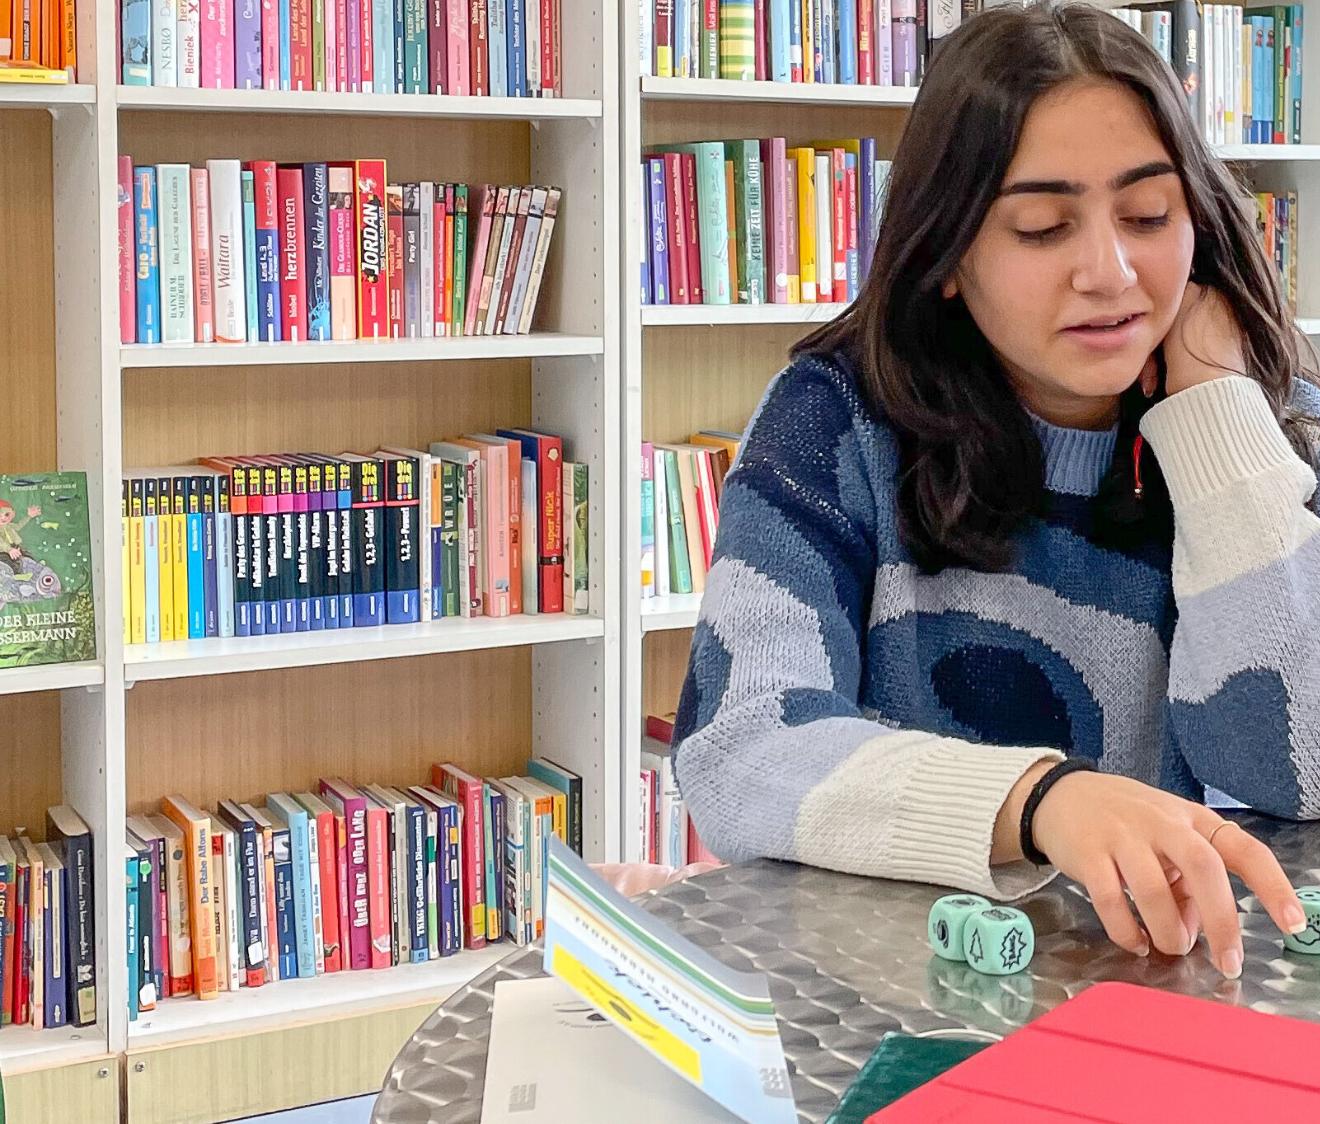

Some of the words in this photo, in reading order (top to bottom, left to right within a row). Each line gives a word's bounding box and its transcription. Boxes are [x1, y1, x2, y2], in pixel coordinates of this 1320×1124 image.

[161, 26, 172, 68] NESBØ
[184, 34, 195, 73] Bieniek
[747, 157, 759, 184] KÜHE
[310, 167, 325, 205] Gezeiten
[748, 186, 759, 206] FÜR
[750, 208, 760, 230] ZEIT
[284, 198, 298, 281] herzbrennen
[311, 219, 325, 250] Kinder
[361, 203, 379, 275] JORDAN
[750, 231, 761, 261] KEINE
[216, 234, 231, 289] Waitara
[408, 245, 416, 263] Party
[287, 294, 298, 318] blobel
[311, 512, 321, 549] VIP-Alarm
[545, 519, 557, 551] Super
[236, 545, 246, 558] des
[236, 559, 247, 579] Party
[26, 610, 76, 627] KLEINE
[350, 810, 366, 839] LANG
[198, 828, 208, 859] Alfons
[353, 839, 366, 865] ODER
[199, 860, 209, 884] Rabe
[355, 872, 367, 896] KURZ
[200, 886, 210, 904] Der
[353, 898, 369, 928] ÜBER
[415, 909, 426, 936] TKKG
